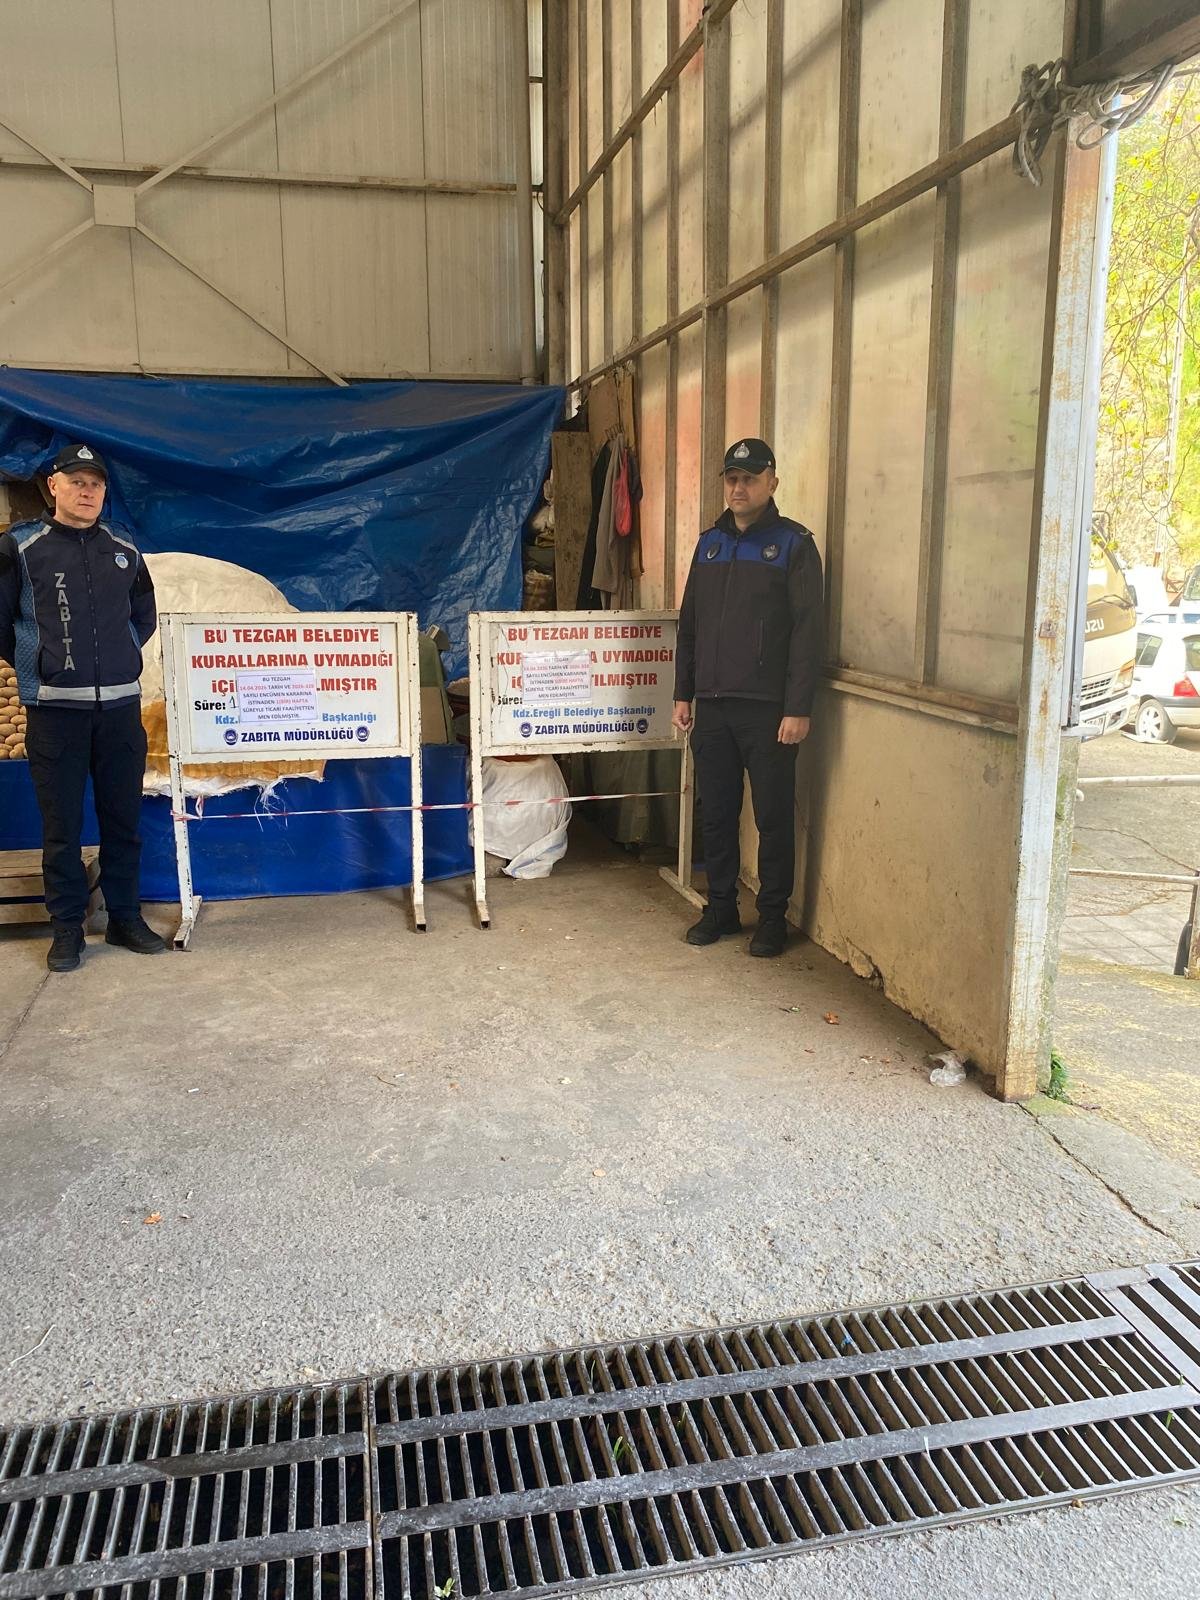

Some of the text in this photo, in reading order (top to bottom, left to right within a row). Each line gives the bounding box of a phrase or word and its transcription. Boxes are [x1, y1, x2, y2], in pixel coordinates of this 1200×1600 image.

[54, 572, 75, 671] ZABITA
[204, 629, 226, 643] BU
[233, 629, 297, 642] TEZGAH
[508, 628, 528, 641] BU
[533, 627, 589, 640] TEZGAH
[192, 650, 393, 668] KURALLARINA UYMADIĞI
[602, 646, 673, 662] UYMADIĞI
[316, 678, 377, 694] MIŞTIR
[591, 673, 658, 689] ILMIŞTIR
[194, 700, 226, 710] Süre:
[513, 705, 656, 719] Kdz.Ereğli Belediye Başkanlığı
[322, 712, 376, 724] Başkanlığı
[241, 726, 354, 742] ZABITA MÜDÜRLÜĞÜ
[535, 722, 635, 735] ZABITA MÜDÜRLÜĞÜ
